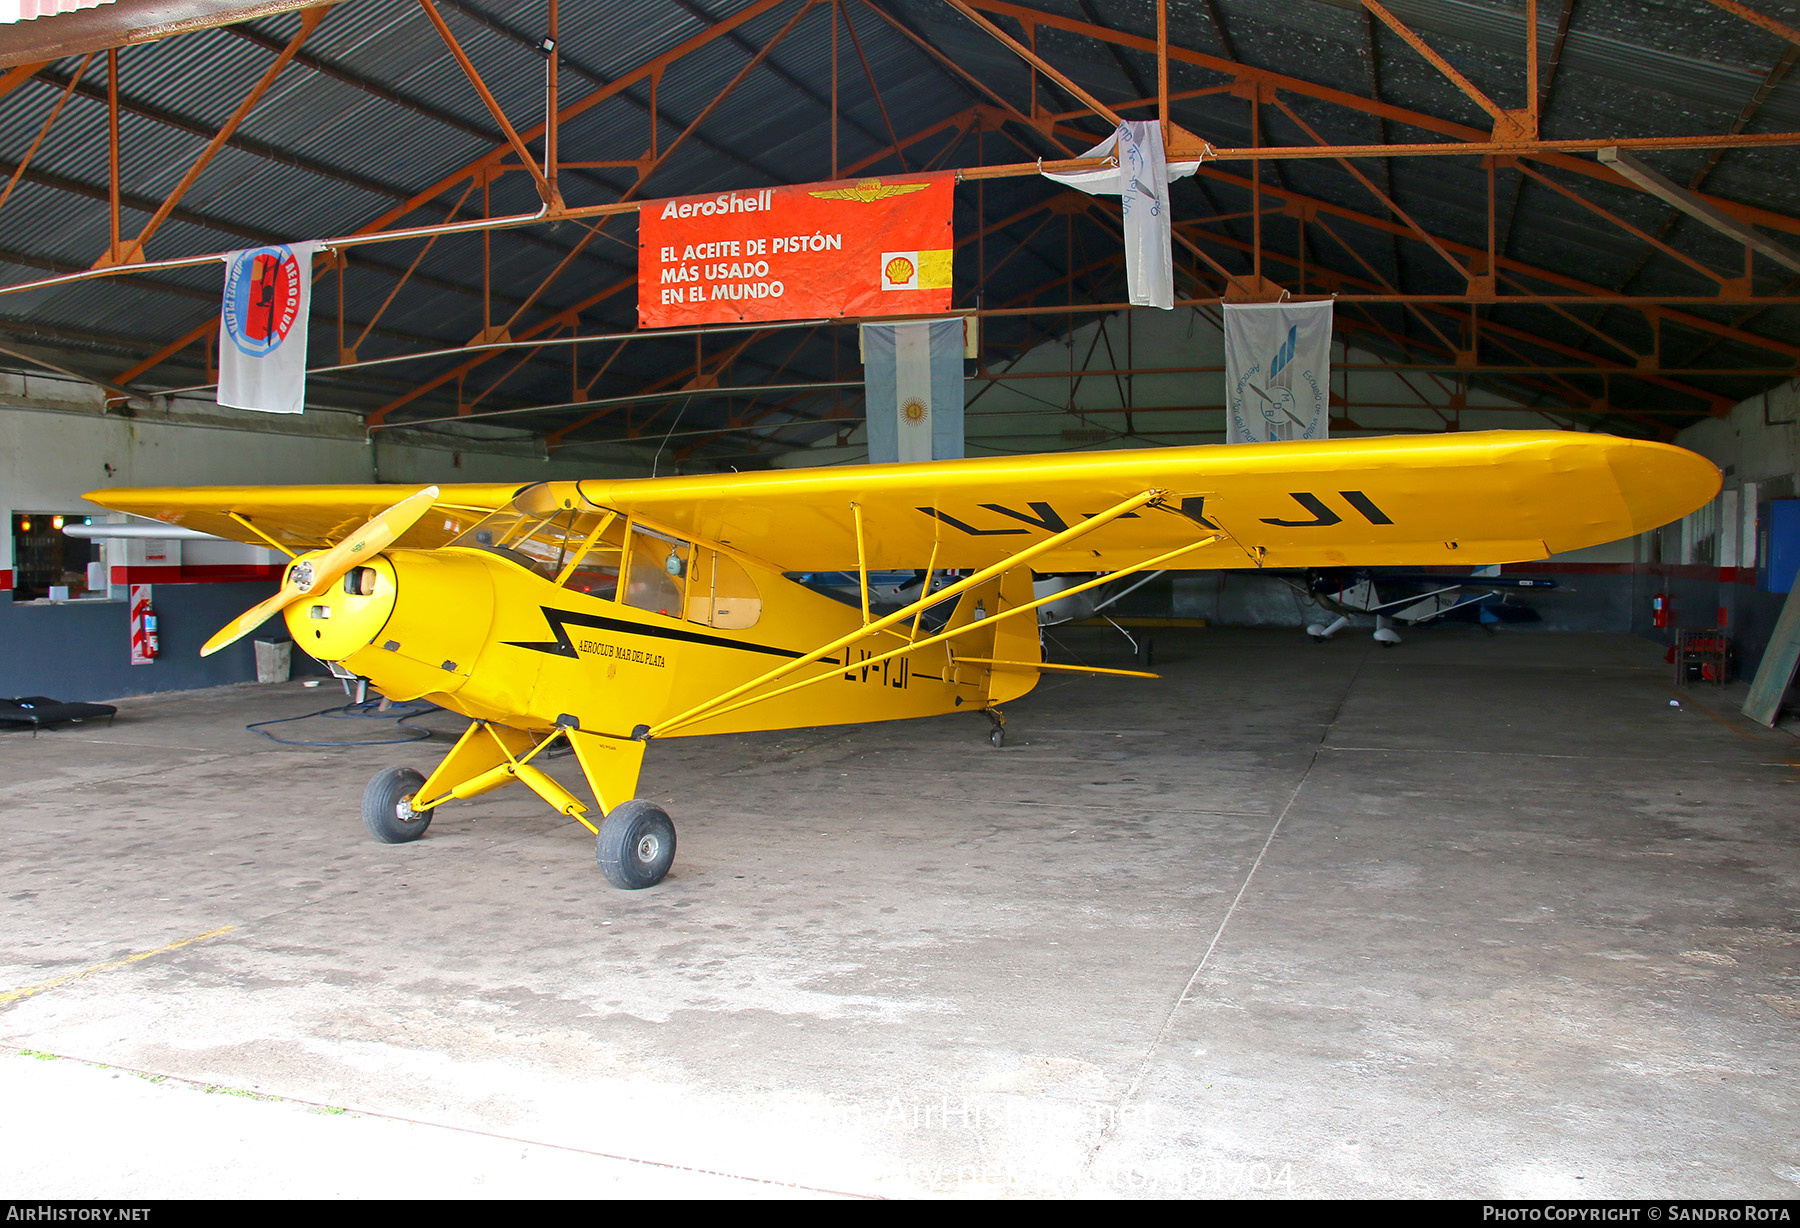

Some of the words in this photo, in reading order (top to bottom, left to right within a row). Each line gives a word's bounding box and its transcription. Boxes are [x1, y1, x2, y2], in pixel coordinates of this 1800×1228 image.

[660, 189, 772, 220] AeroShell
[660, 246, 678, 263] EL
[682, 240, 740, 261] ACEITE
[746, 238, 767, 256] DE
[772, 230, 842, 254] PISTÓN
[660, 262, 700, 284] MÁS
[705, 260, 770, 280] USADO
[226, 280, 237, 298] DEL
[280, 262, 298, 333] AEROCLUB
[661, 288, 684, 305] EN
[689, 286, 707, 303] EL
[711, 281, 785, 302] MUNDO
[226, 300, 239, 334] PLATA
[578, 640, 614, 658] AEROCLUB
[615, 647, 631, 662] MAR
[631, 650, 646, 665] DEL
[646, 652, 666, 668] PLATA
[844, 646, 908, 690] LV-YJI
